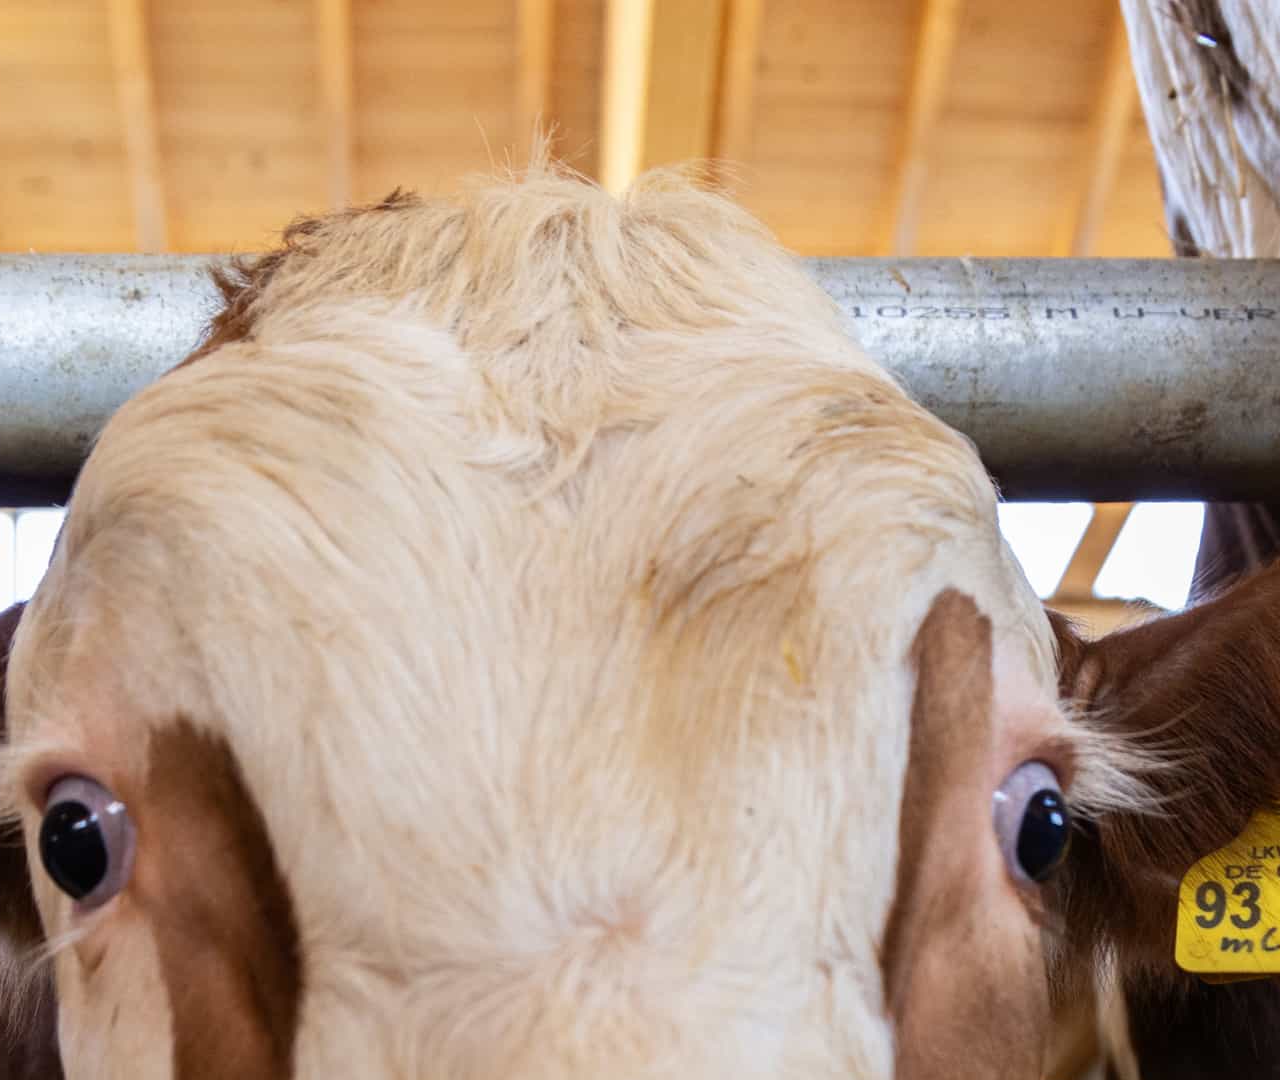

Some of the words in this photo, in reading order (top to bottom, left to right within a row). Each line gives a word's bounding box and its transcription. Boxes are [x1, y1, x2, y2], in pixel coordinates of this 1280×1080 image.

[1045, 306, 1078, 320] M
[1224, 864, 1265, 879] DE
[1194, 880, 1262, 929] 93
